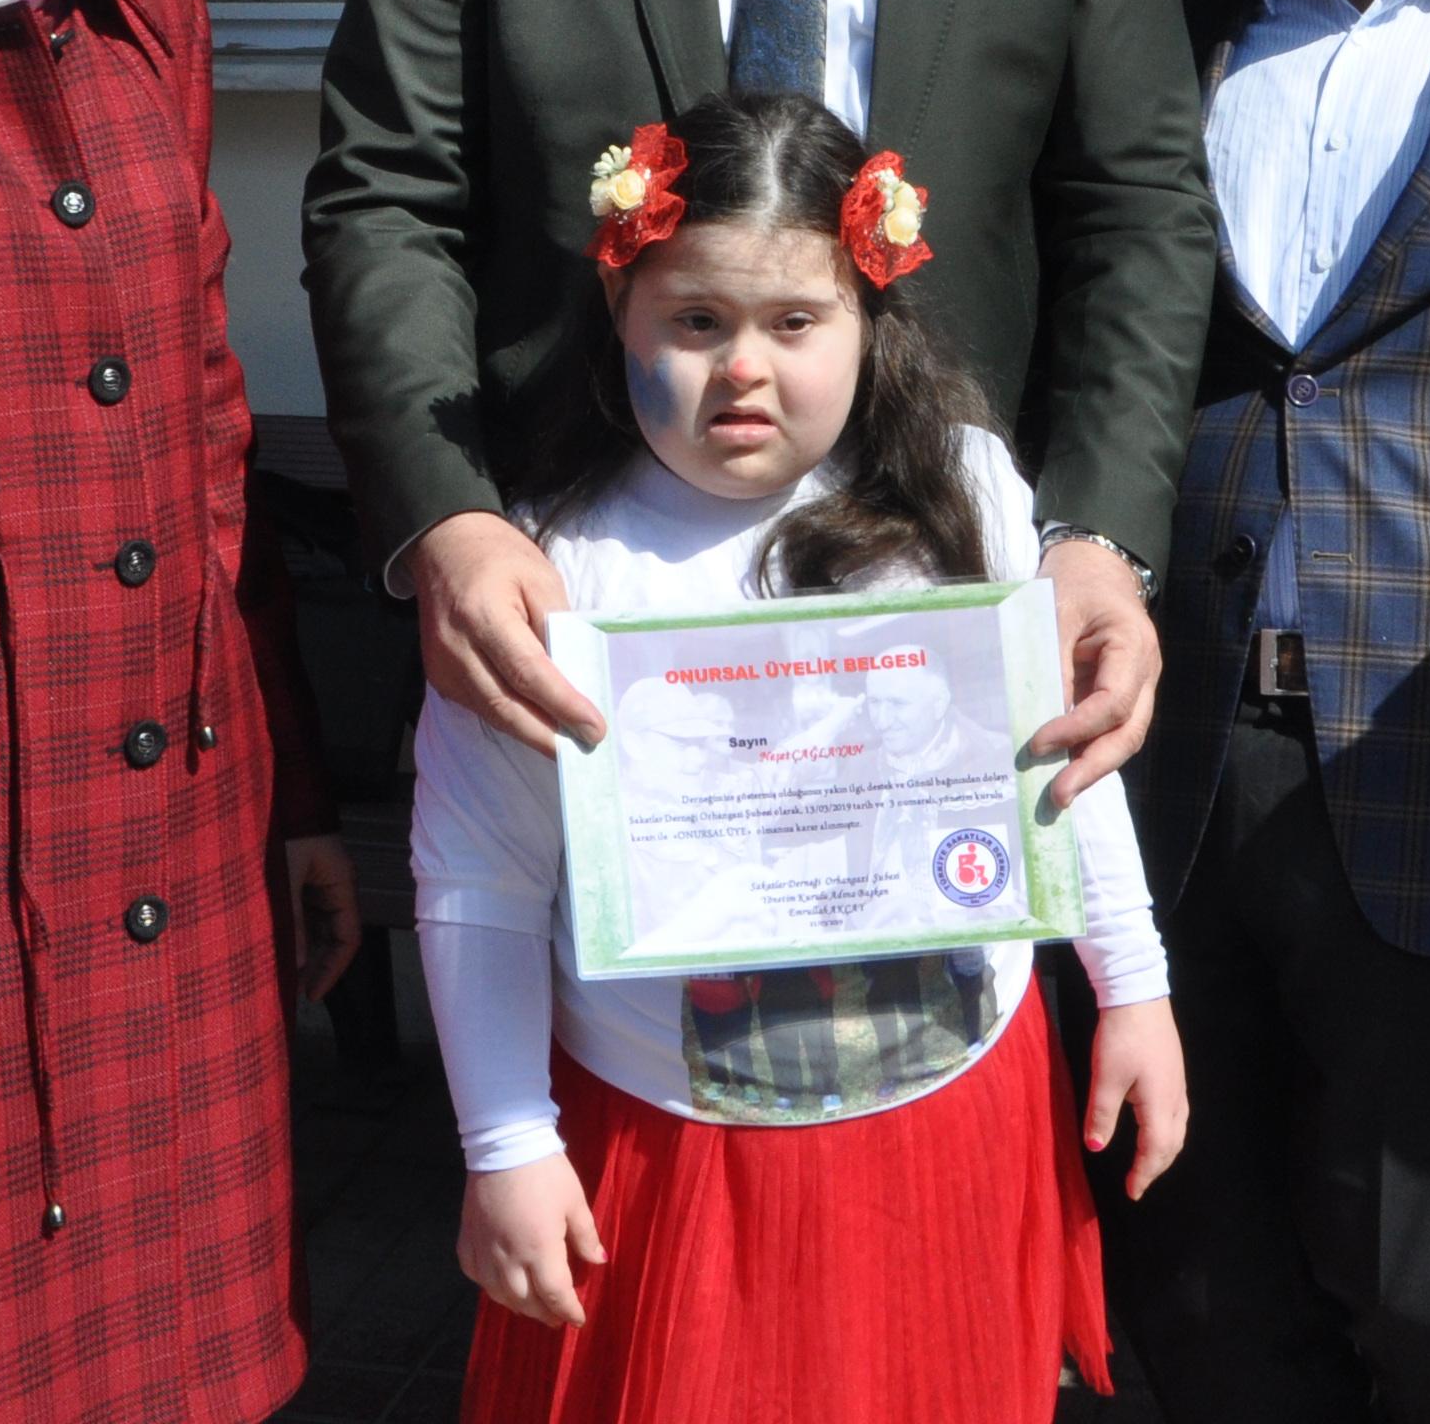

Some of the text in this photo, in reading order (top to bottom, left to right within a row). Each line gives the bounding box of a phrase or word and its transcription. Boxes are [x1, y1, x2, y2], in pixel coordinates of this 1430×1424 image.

[665, 649, 927, 685] ONURSAL ÜYELİK BELGESİ
[729, 736, 767, 750] Sayın
